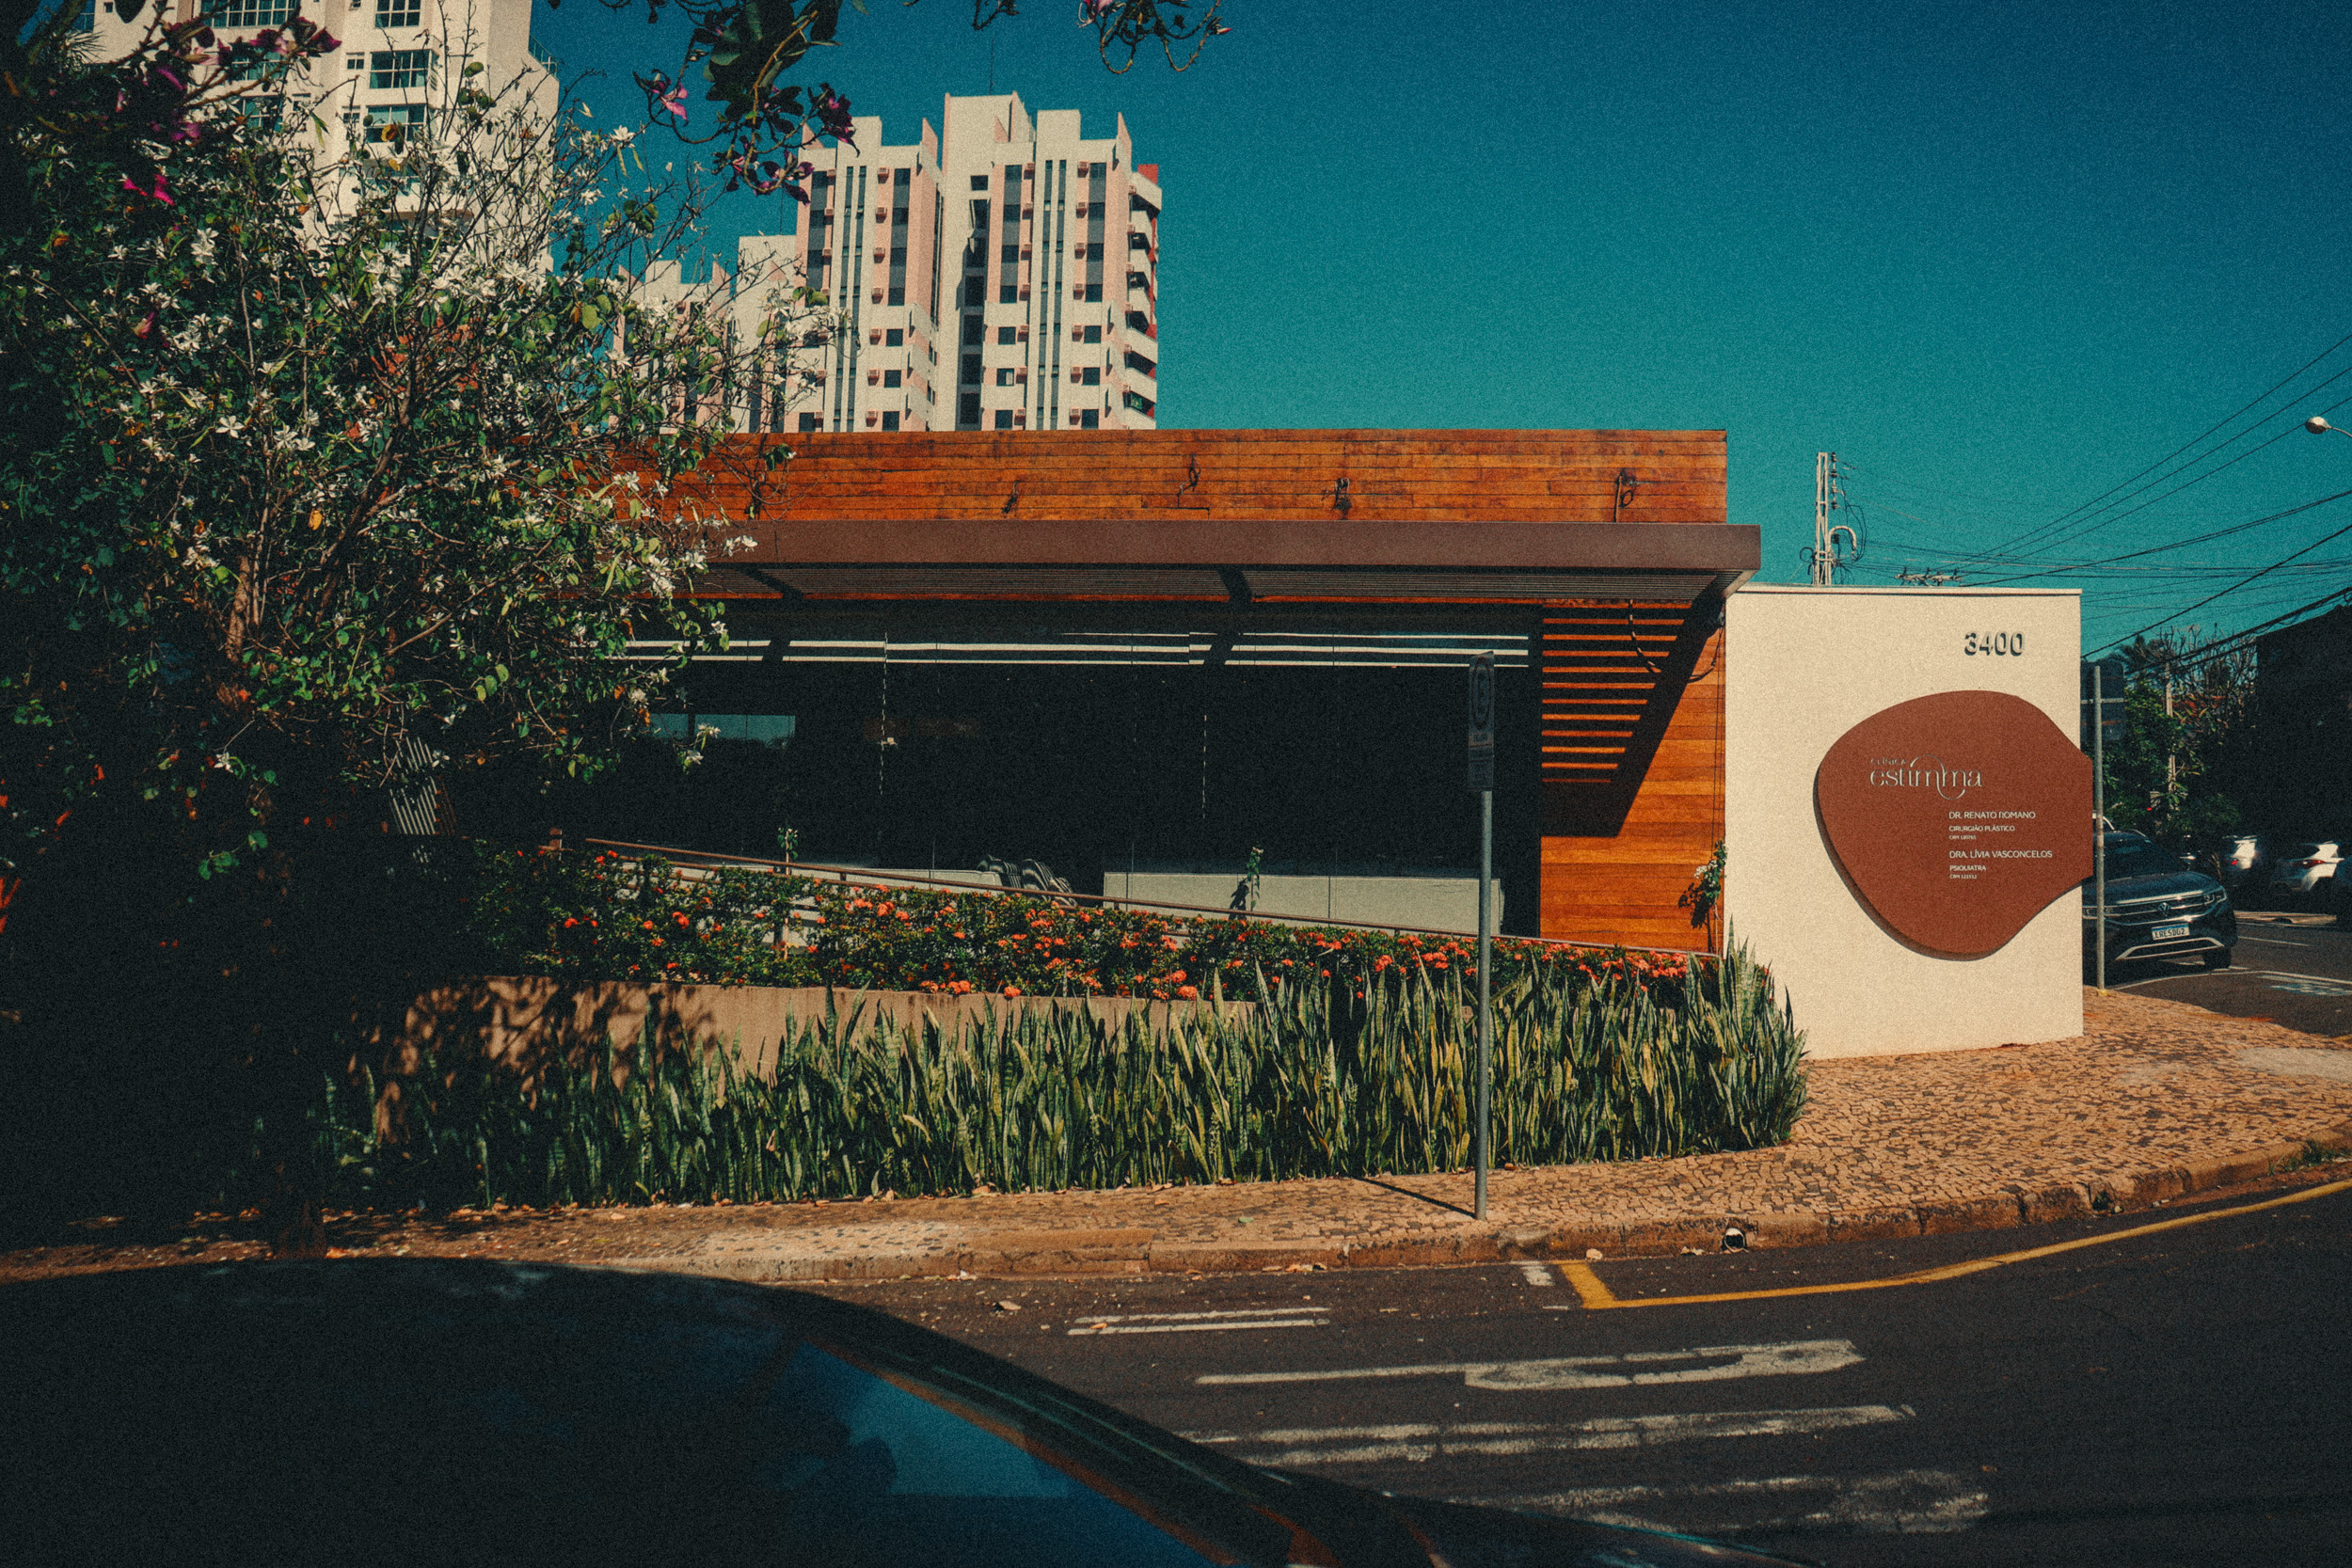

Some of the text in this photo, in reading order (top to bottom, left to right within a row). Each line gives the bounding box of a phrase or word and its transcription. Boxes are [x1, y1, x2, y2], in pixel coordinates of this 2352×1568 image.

[1963, 630, 2026, 657] 3400
[1948, 811, 2037, 819] DR. RENATO ROMANO
[1948, 824, 1984, 832] CIRURGIÃO
[1949, 850, 1968, 859] DRA.
[1969, 848, 1991, 859] LÍVIA
